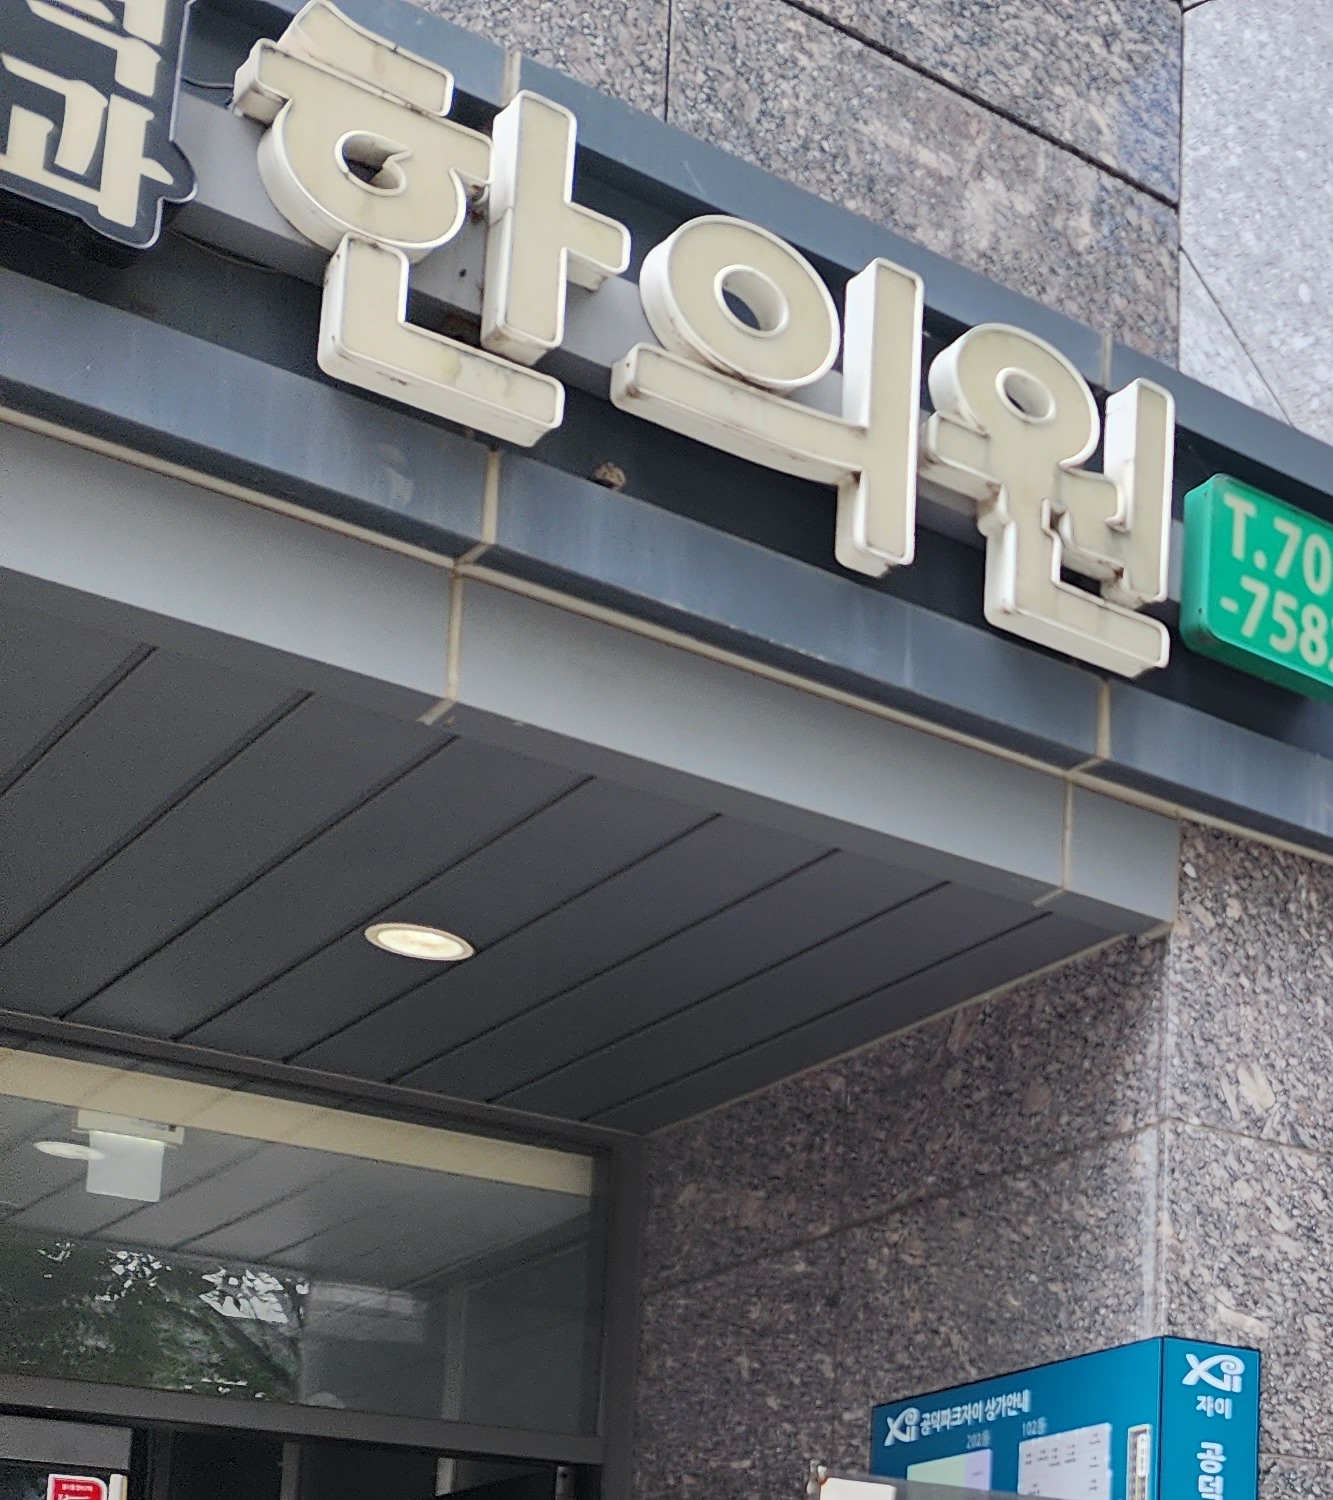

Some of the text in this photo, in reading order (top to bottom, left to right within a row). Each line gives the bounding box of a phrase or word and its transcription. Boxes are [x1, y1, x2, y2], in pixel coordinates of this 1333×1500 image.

[234, 0, 1175, 678] 한의원
[920, 1389, 1032, 1436] 공덕파크자이 상가안내
[1195, 1395, 1232, 1420] 자이
